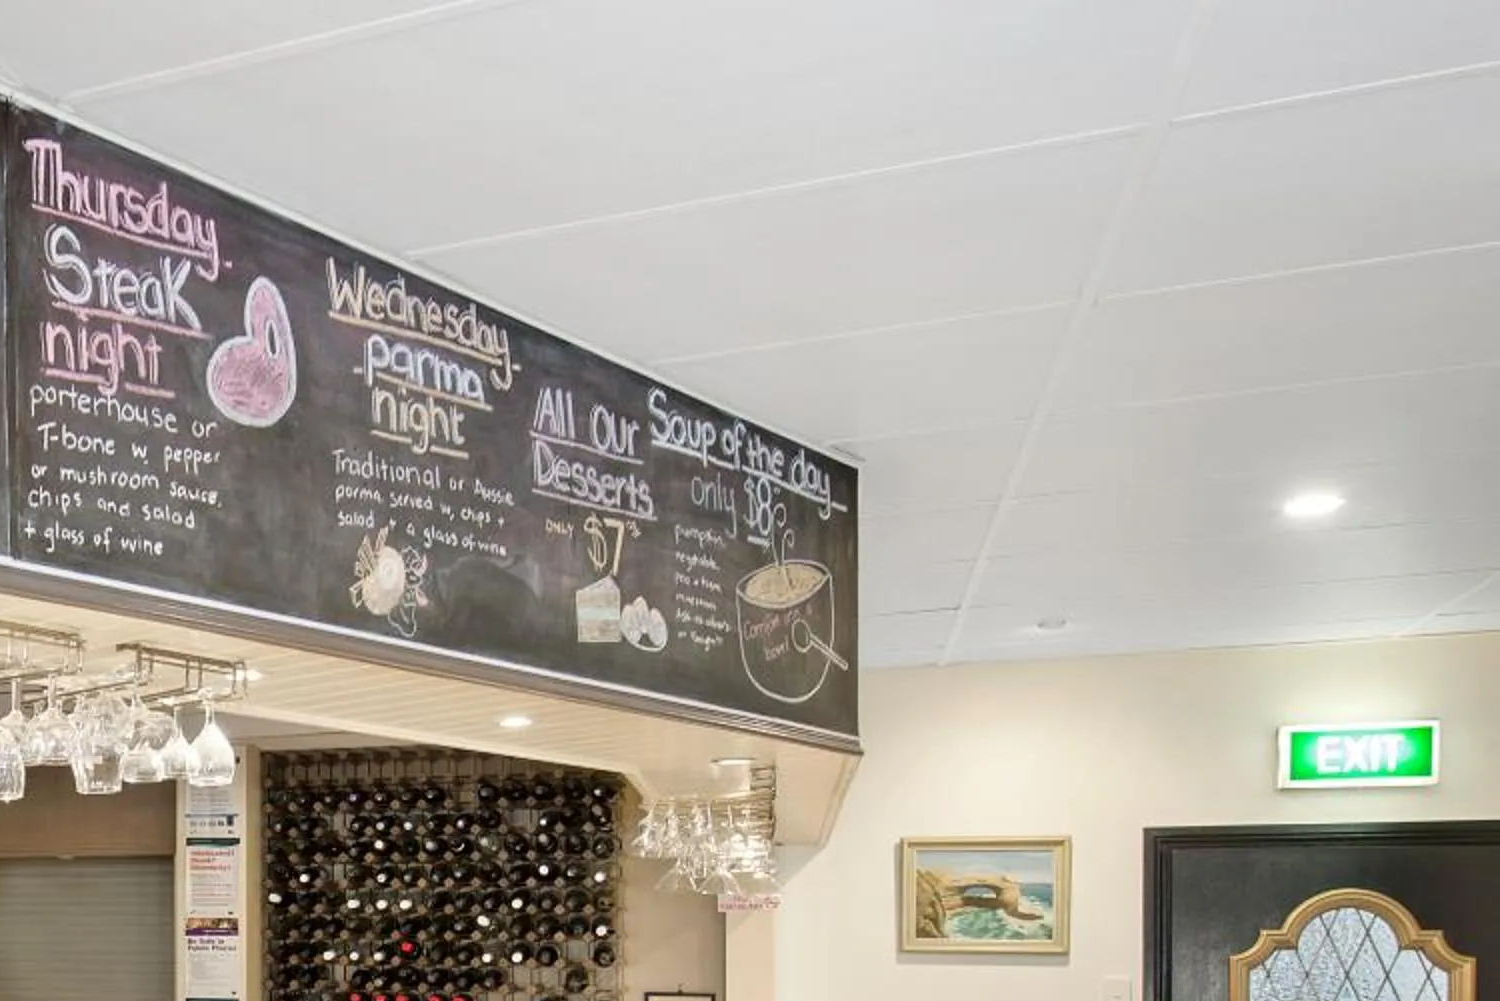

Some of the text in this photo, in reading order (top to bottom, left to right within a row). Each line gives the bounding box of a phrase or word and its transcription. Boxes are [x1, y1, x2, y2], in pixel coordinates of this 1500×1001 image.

[22, 138, 220, 283] Thursday
[325, 256, 513, 391] Wednesday
[41, 312, 161, 396] night
[29, 384, 218, 439] porterhouse or
[370, 385, 466, 454] night
[533, 388, 575, 441] All
[37, 421, 116, 456] T-bone
[163, 445, 221, 475] pepper
[332, 449, 441, 490] Traditional
[449, 479, 465, 491] or
[648, 387, 831, 520] Soup of the day
[31, 463, 48, 479] or
[59, 466, 160, 490] mushroom
[335, 484, 383, 504] parma
[532, 441, 653, 515] Desserts
[28, 486, 195, 529] chips and salad
[337, 510, 375, 529] salad
[423, 525, 458, 549] glass
[44, 521, 85, 553] glass
[93, 527, 113, 554] of
[120, 536, 164, 556] wine
[1317, 733, 1405, 774] EXIT
